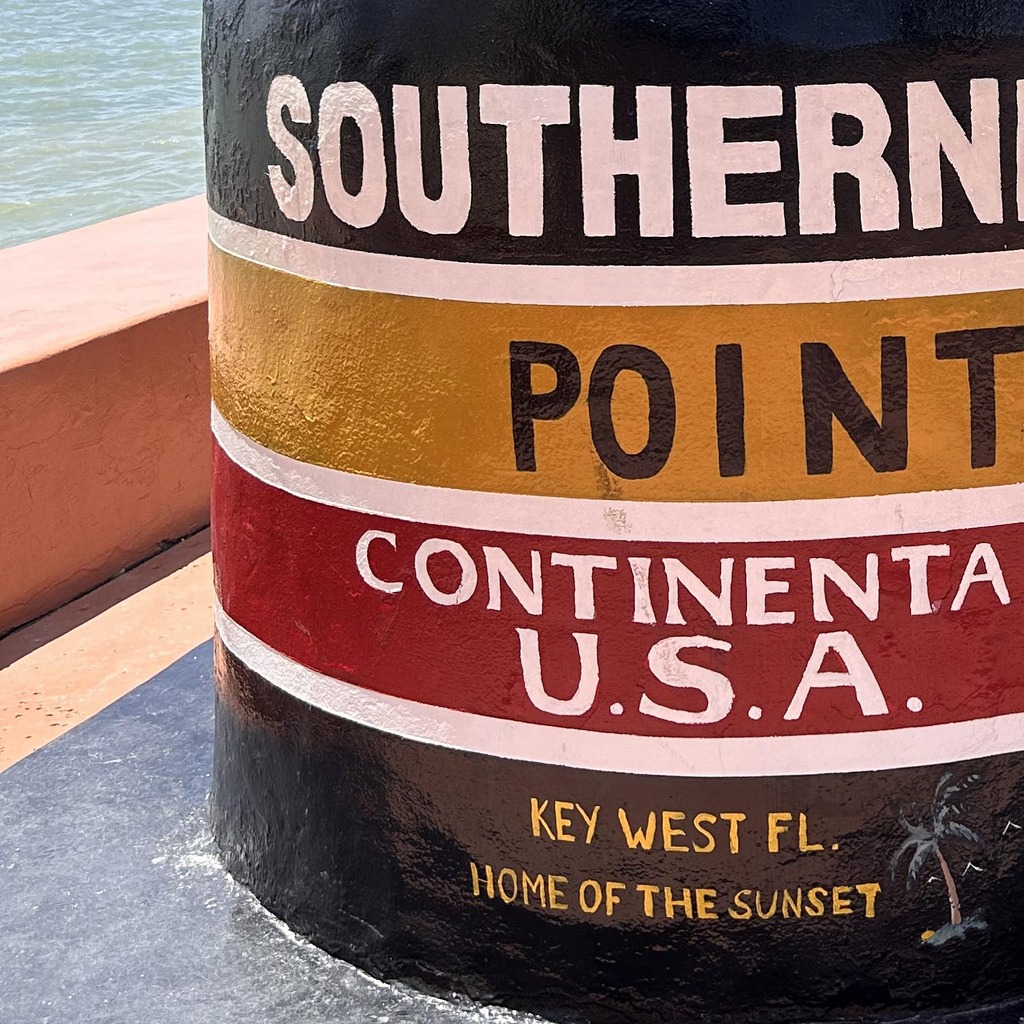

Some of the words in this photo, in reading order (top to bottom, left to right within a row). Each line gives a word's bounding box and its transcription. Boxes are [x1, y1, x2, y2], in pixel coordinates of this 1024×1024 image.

[516, 627, 923, 724] U.S.A.
[529, 797, 600, 845] KEY
[618, 807, 747, 854] WEST
[767, 812, 840, 853] FL.
[470, 862, 568, 910] HOME
[578, 879, 627, 916] OF
[636, 884, 719, 921] THE
[728, 882, 882, 921] SUNSET
